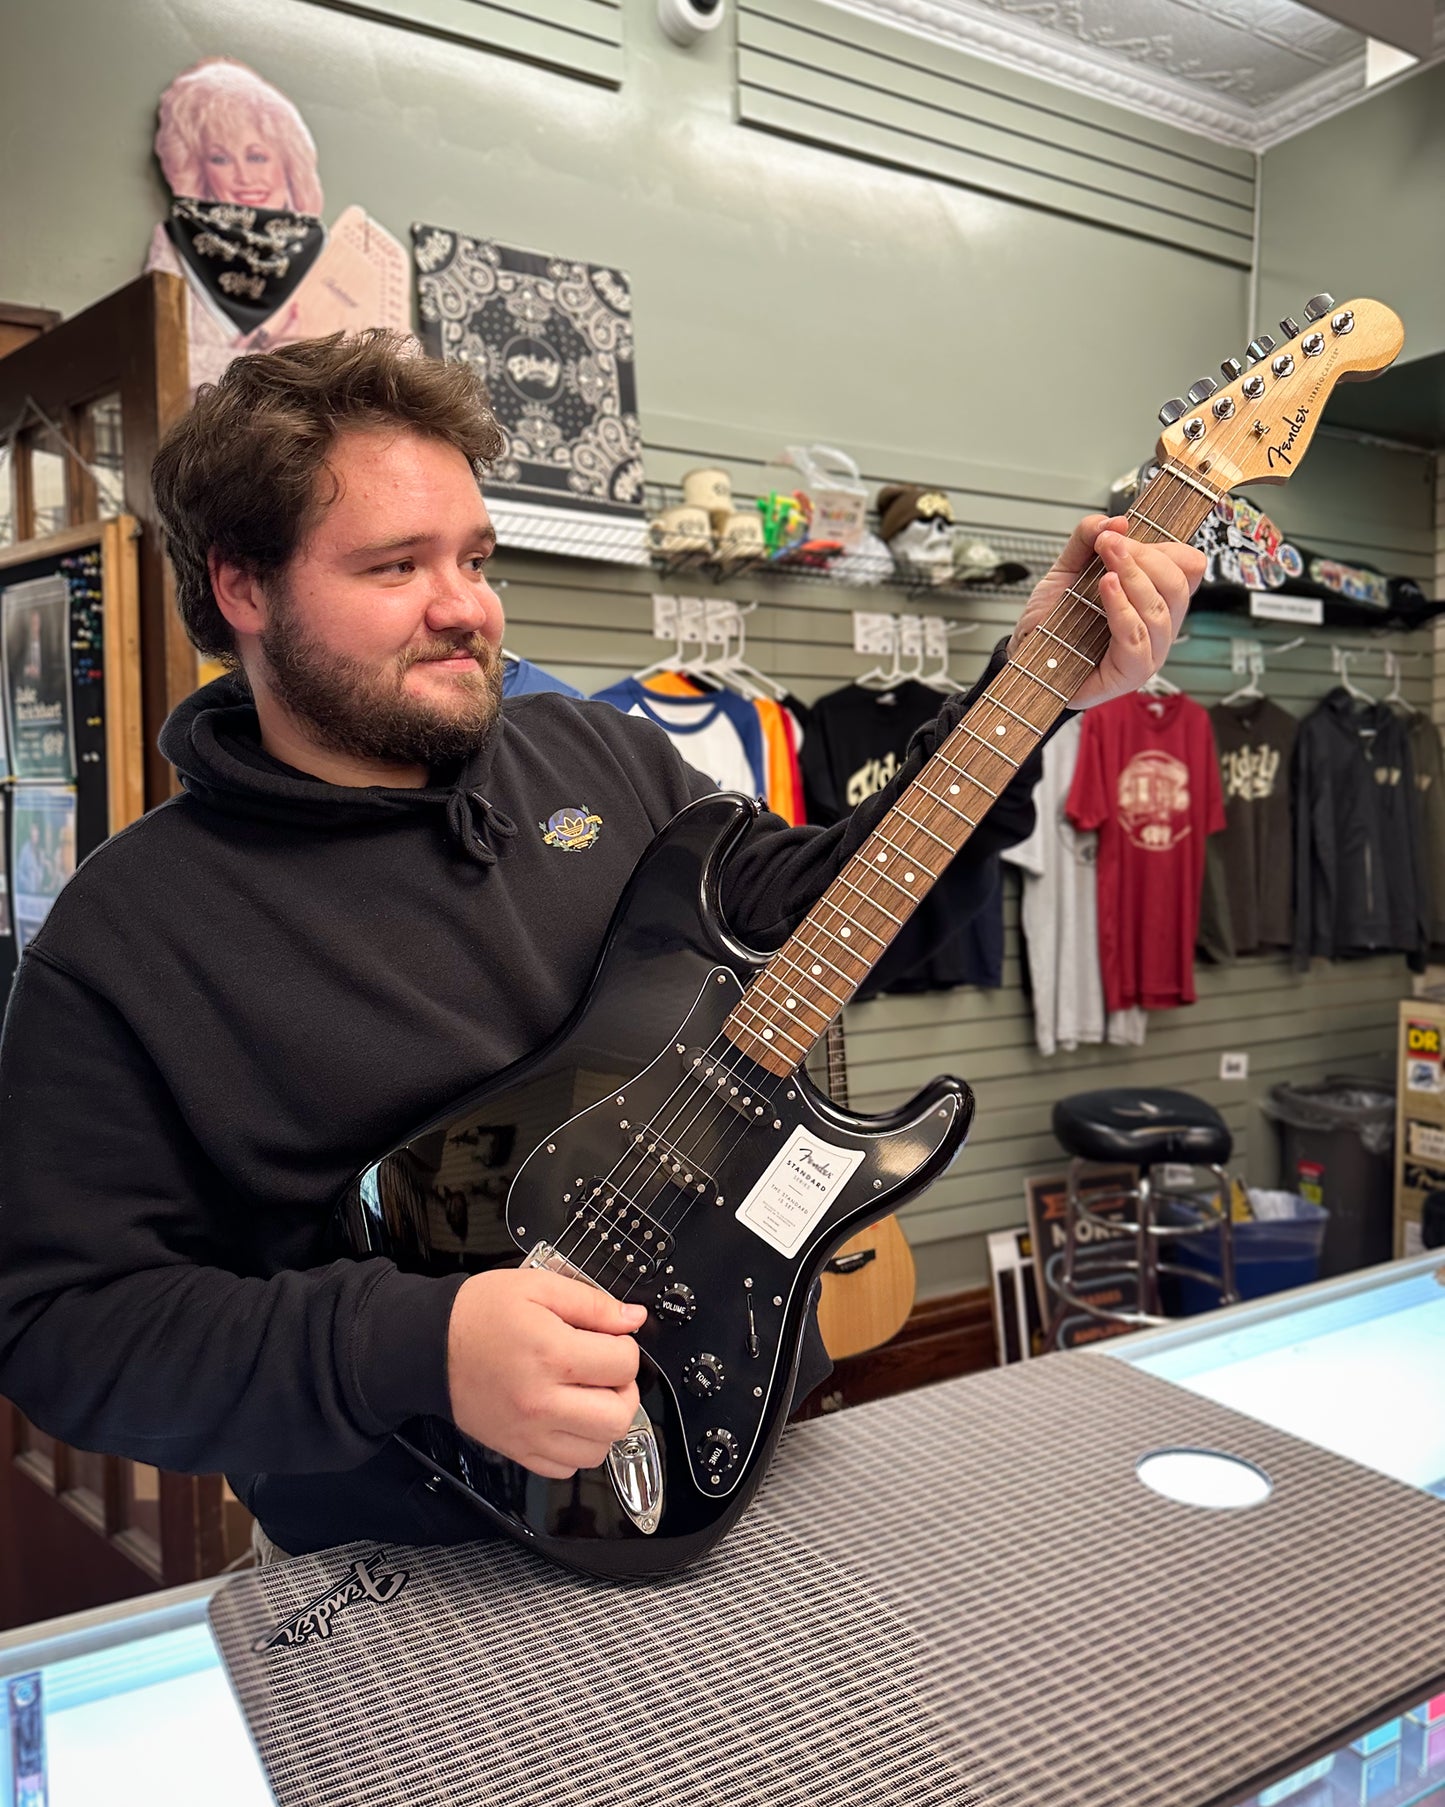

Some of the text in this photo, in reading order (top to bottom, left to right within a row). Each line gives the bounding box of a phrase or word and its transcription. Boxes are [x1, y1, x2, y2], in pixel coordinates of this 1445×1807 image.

[1267, 405, 1309, 468] Fender
[1409, 1029, 1440, 1052] DR
[799, 1148, 834, 1179] Fender
[786, 1160, 826, 1192] STANDARD
[793, 1175, 810, 1190] SERIES
[770, 1184, 781, 1194] THE
[782, 1192, 809, 1215] STANDARD
[784, 1203, 794, 1211] SET
[662, 1300, 687, 1315] VOLUME
[695, 1370, 712, 1389] TONE
[708, 1447, 723, 1466] TONE
